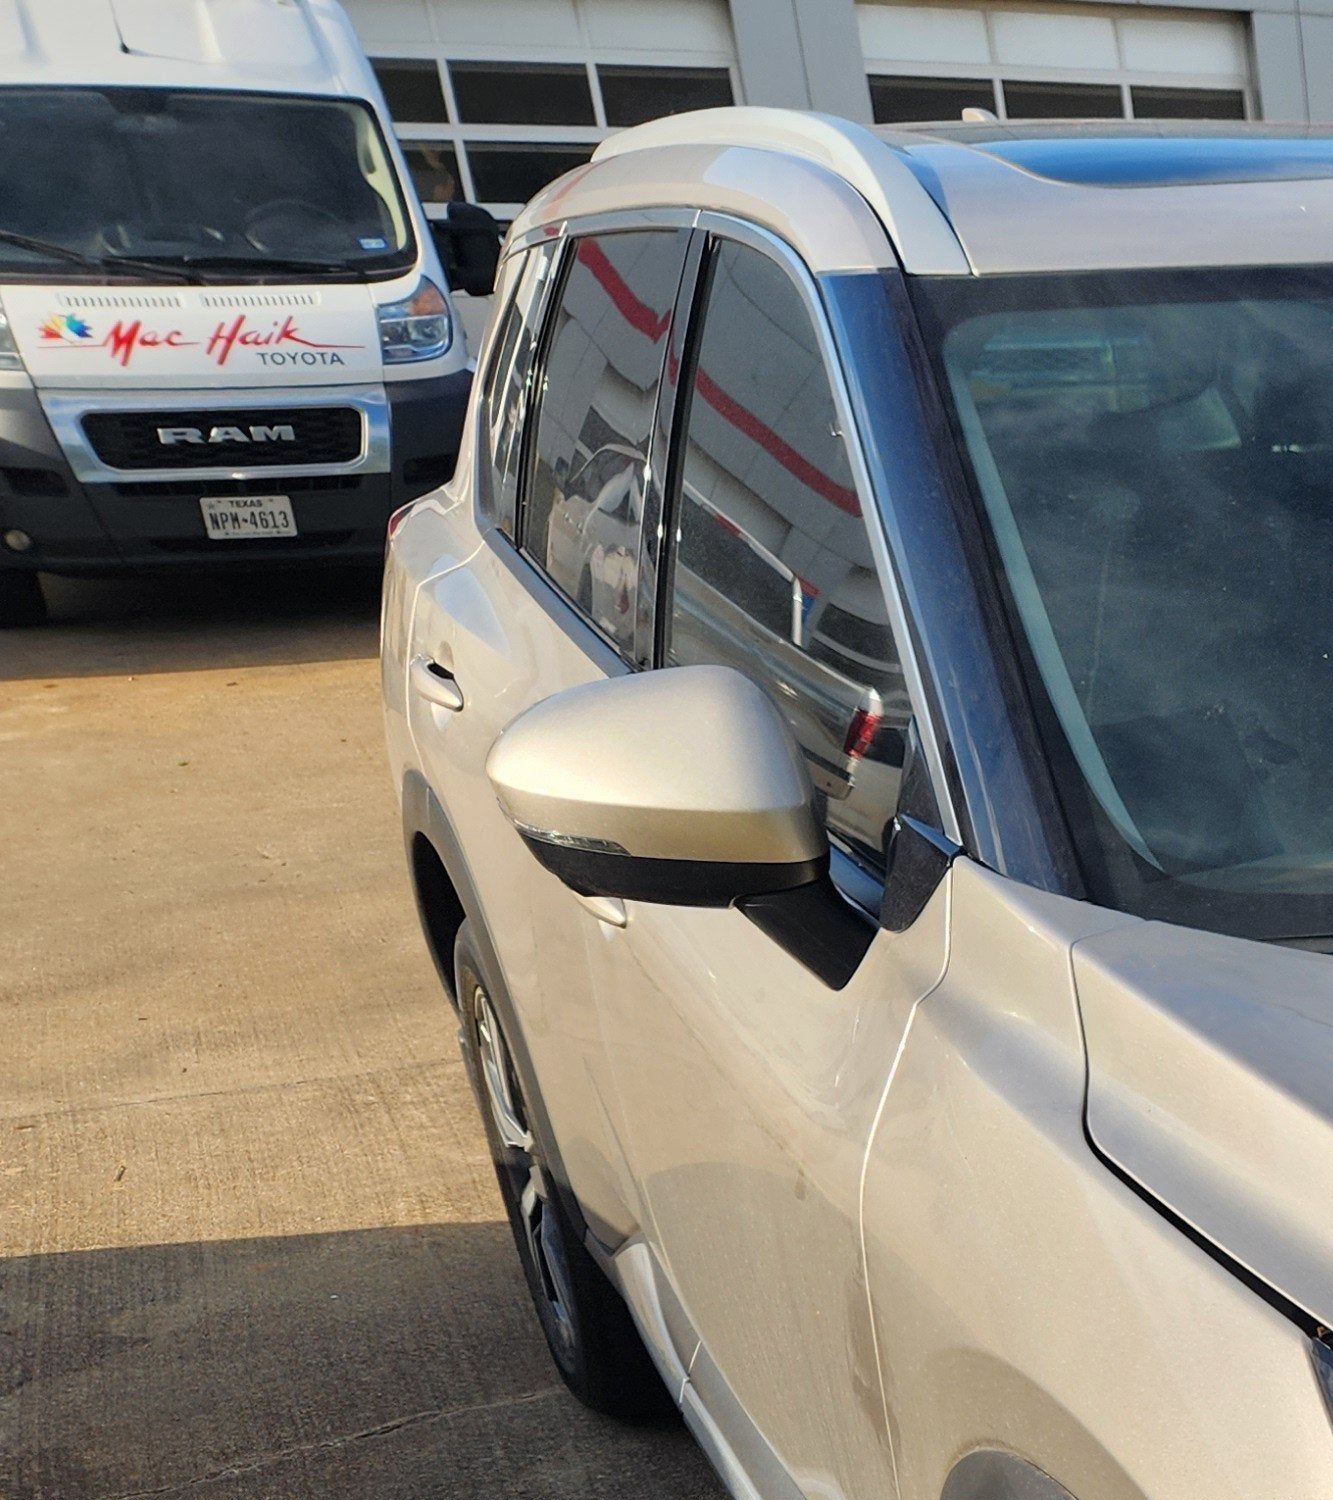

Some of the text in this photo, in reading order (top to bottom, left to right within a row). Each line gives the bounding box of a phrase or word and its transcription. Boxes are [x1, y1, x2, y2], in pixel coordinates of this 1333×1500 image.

[102, 315, 348, 367] Mac Haik
[258, 351, 346, 366] TOYOTA
[156, 425, 297, 445] RAM
[229, 499, 263, 508] TEXAS
